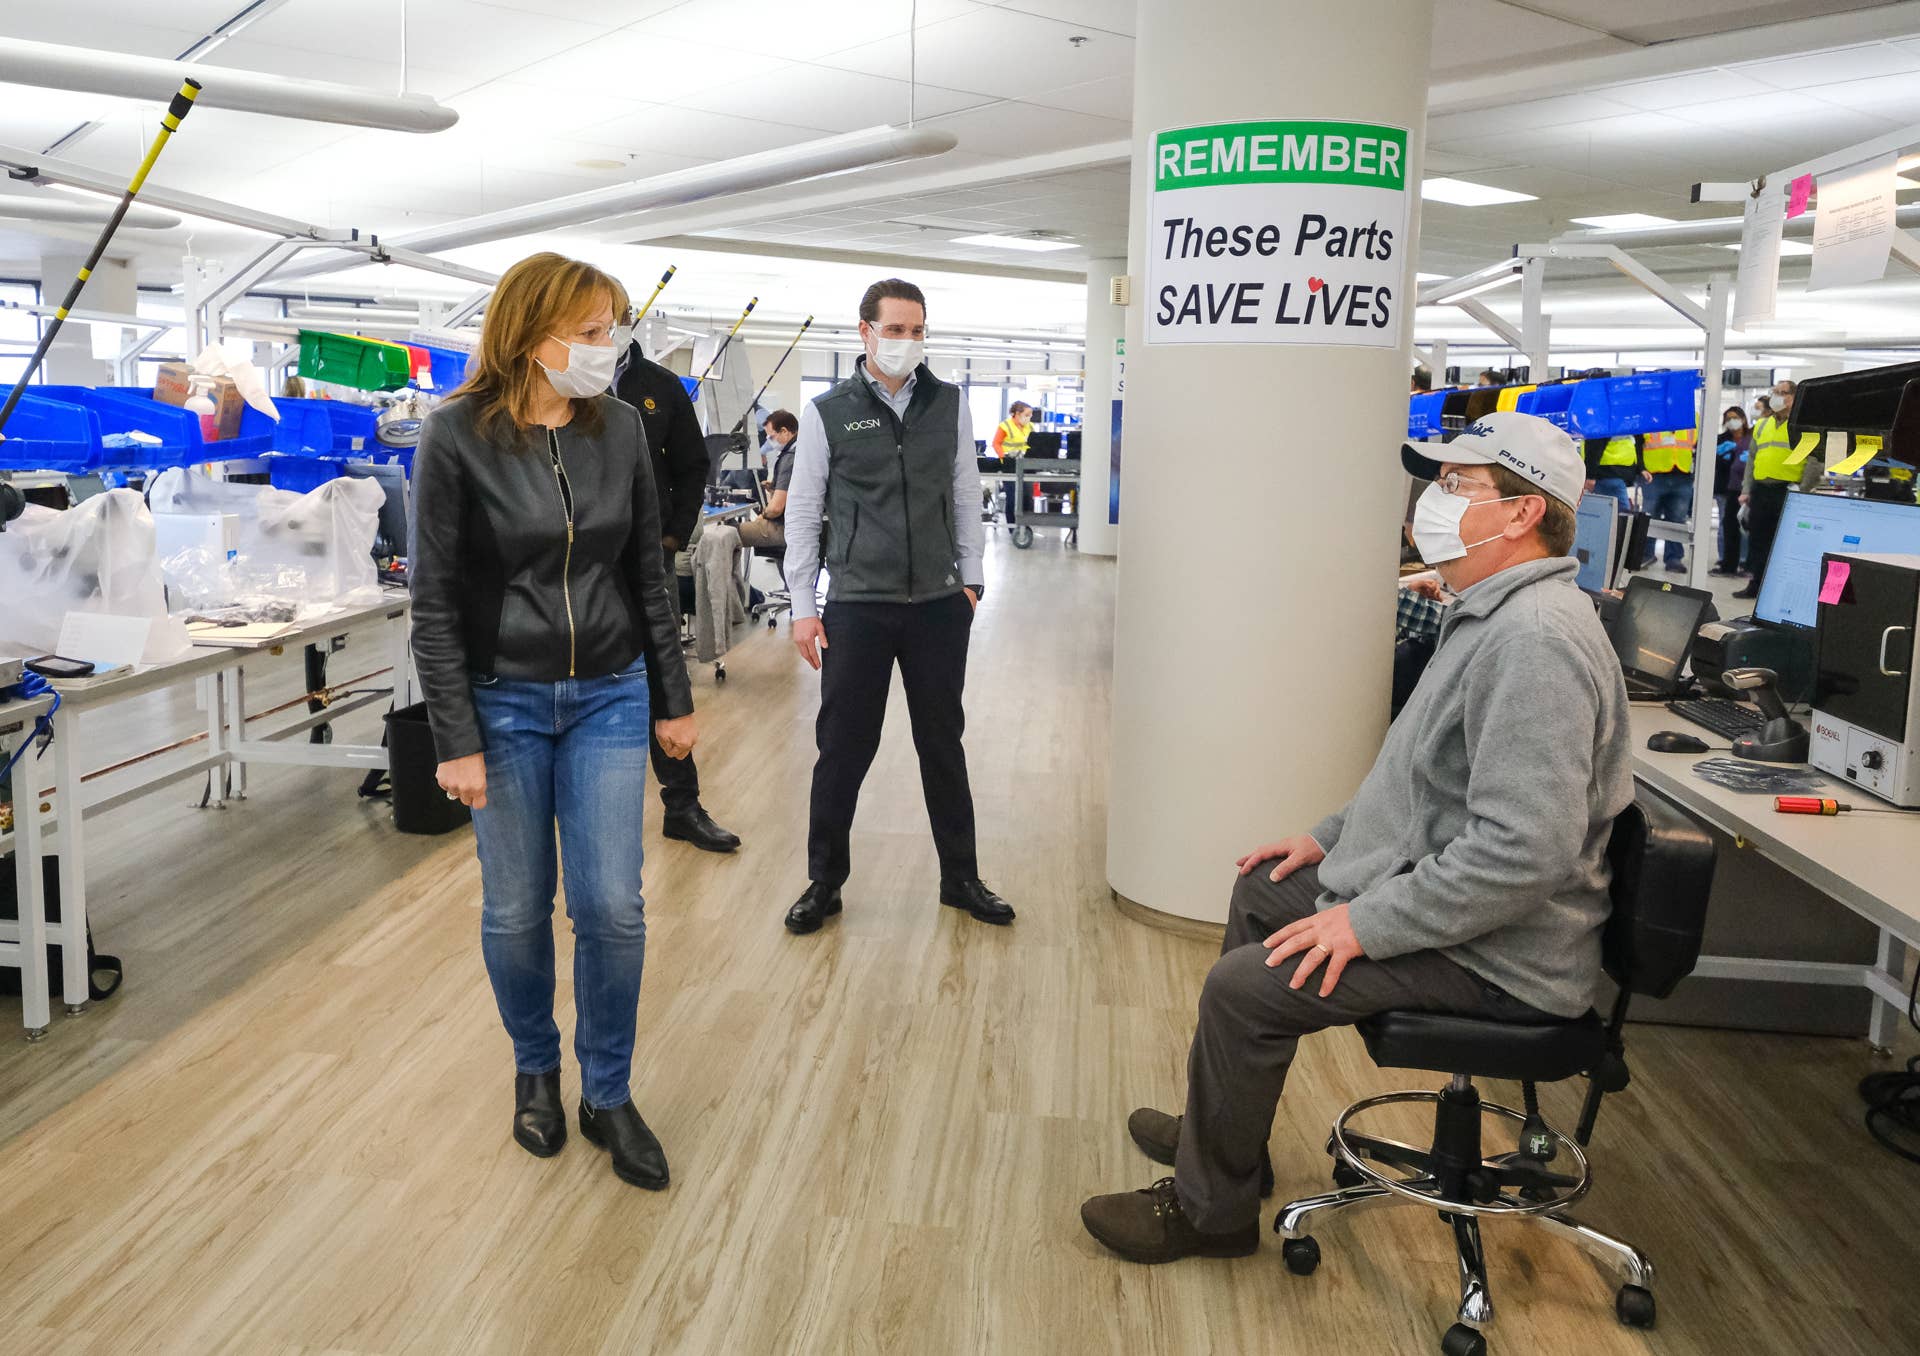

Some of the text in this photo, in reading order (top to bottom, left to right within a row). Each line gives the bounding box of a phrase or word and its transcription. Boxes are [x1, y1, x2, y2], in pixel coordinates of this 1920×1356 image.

[1158, 134, 1401, 180] REMEMBER
[1163, 213, 1394, 261] These Parts
[1156, 282, 1265, 326] SAVE
[843, 418, 880, 431] VOCSN
[1530, 465, 1546, 481] V1
